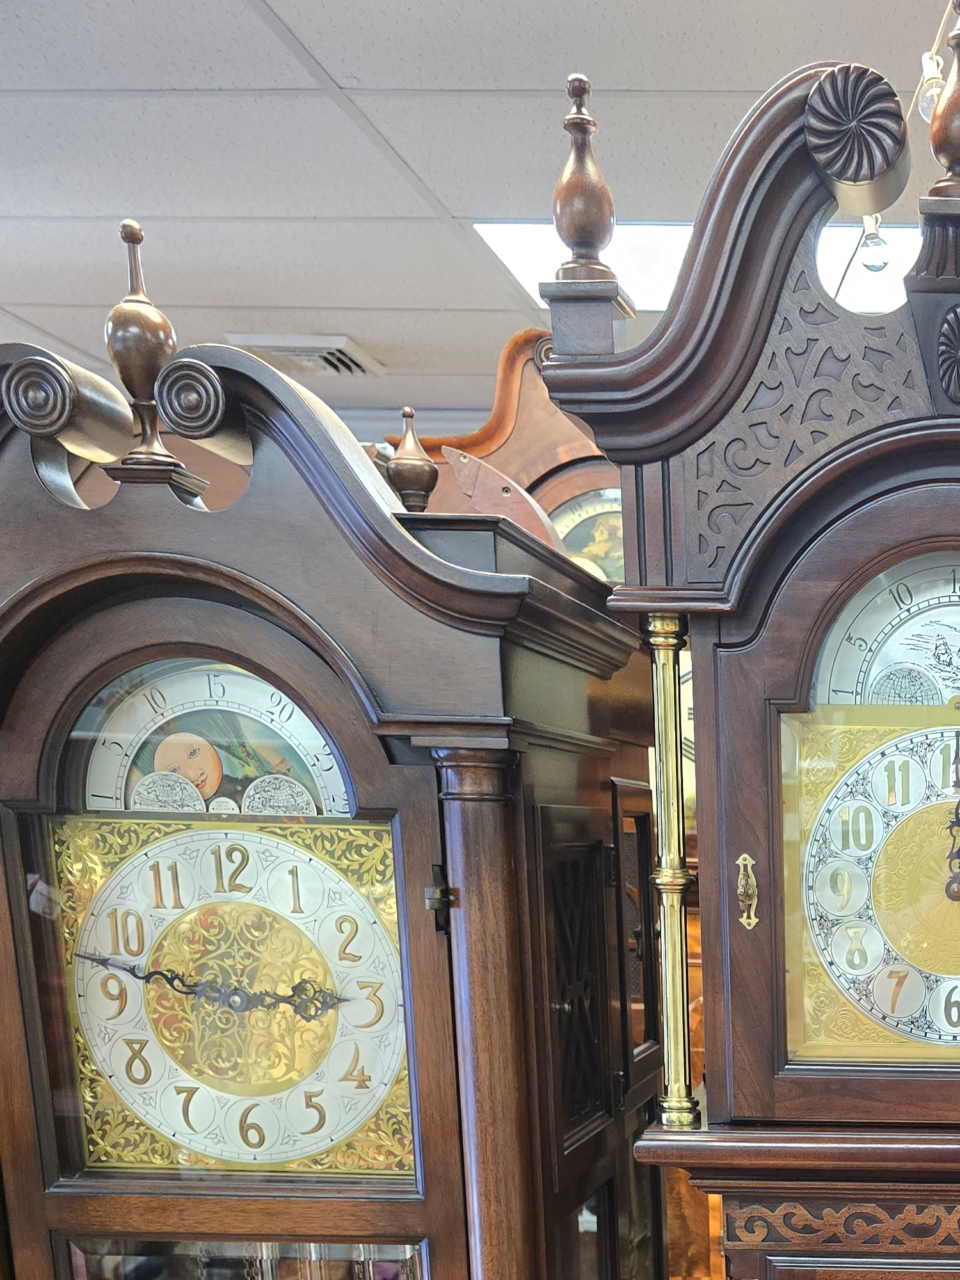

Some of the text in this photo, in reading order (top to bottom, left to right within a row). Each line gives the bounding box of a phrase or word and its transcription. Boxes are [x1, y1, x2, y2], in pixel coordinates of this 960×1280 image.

[888, 582, 913, 611] 10
[848, 632, 868, 652] 5
[142, 687, 167, 714] 10
[206, 673, 226, 699] 15
[263, 691, 295, 724] 20
[101, 739, 124, 757] 5
[885, 760, 909, 807] 11
[840, 805, 873, 852] 10
[149, 861, 185, 909] 11
[210, 844, 251, 894] 12
[288, 865, 302, 914] 1
[829, 867, 851, 912] 9
[109, 908, 145, 956] 10
[336, 915, 362, 962] 2
[845, 926, 867, 971] 8
[100, 972, 128, 1020] 9
[355, 982, 384, 1029] 3
[885, 970, 908, 1014] 7
[124, 1038, 151, 1085] 8
[339, 1042, 371, 1089] 4
[174, 1086, 199, 1132] 7
[239, 1104, 265, 1149] 6
[300, 1090, 326, 1135] 5
